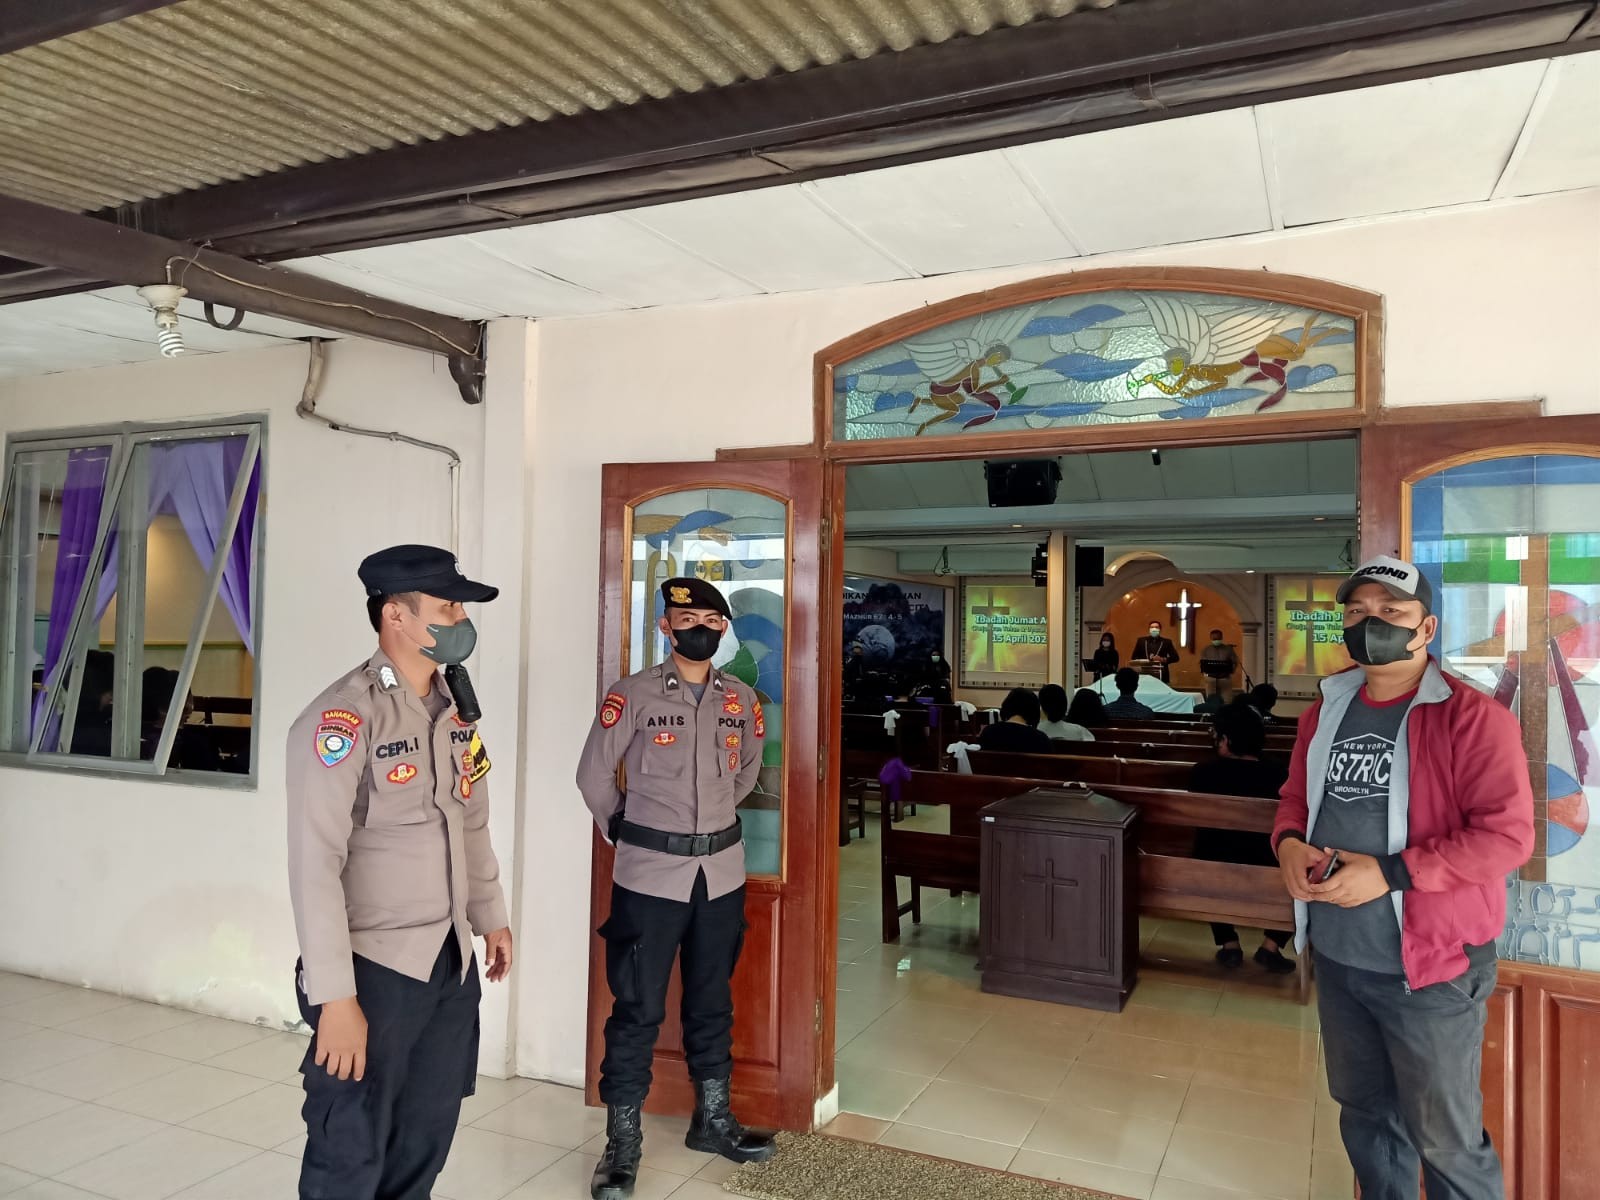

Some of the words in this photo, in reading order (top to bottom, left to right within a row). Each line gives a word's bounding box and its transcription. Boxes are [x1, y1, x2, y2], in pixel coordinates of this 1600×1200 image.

[975, 614, 1008, 624] Ibadah
[1009, 615, 1039, 625] Jumat
[1291, 611, 1333, 621] Ibadah
[992, 634, 1004, 643] 15
[1005, 634, 1028, 646] April
[1312, 633, 1328, 642] 15
[647, 715, 685, 728] ANIS
[1343, 742, 1364, 750] NEW
[1367, 743, 1388, 751] YORK
[1334, 785, 1369, 794] BROOKLYN
